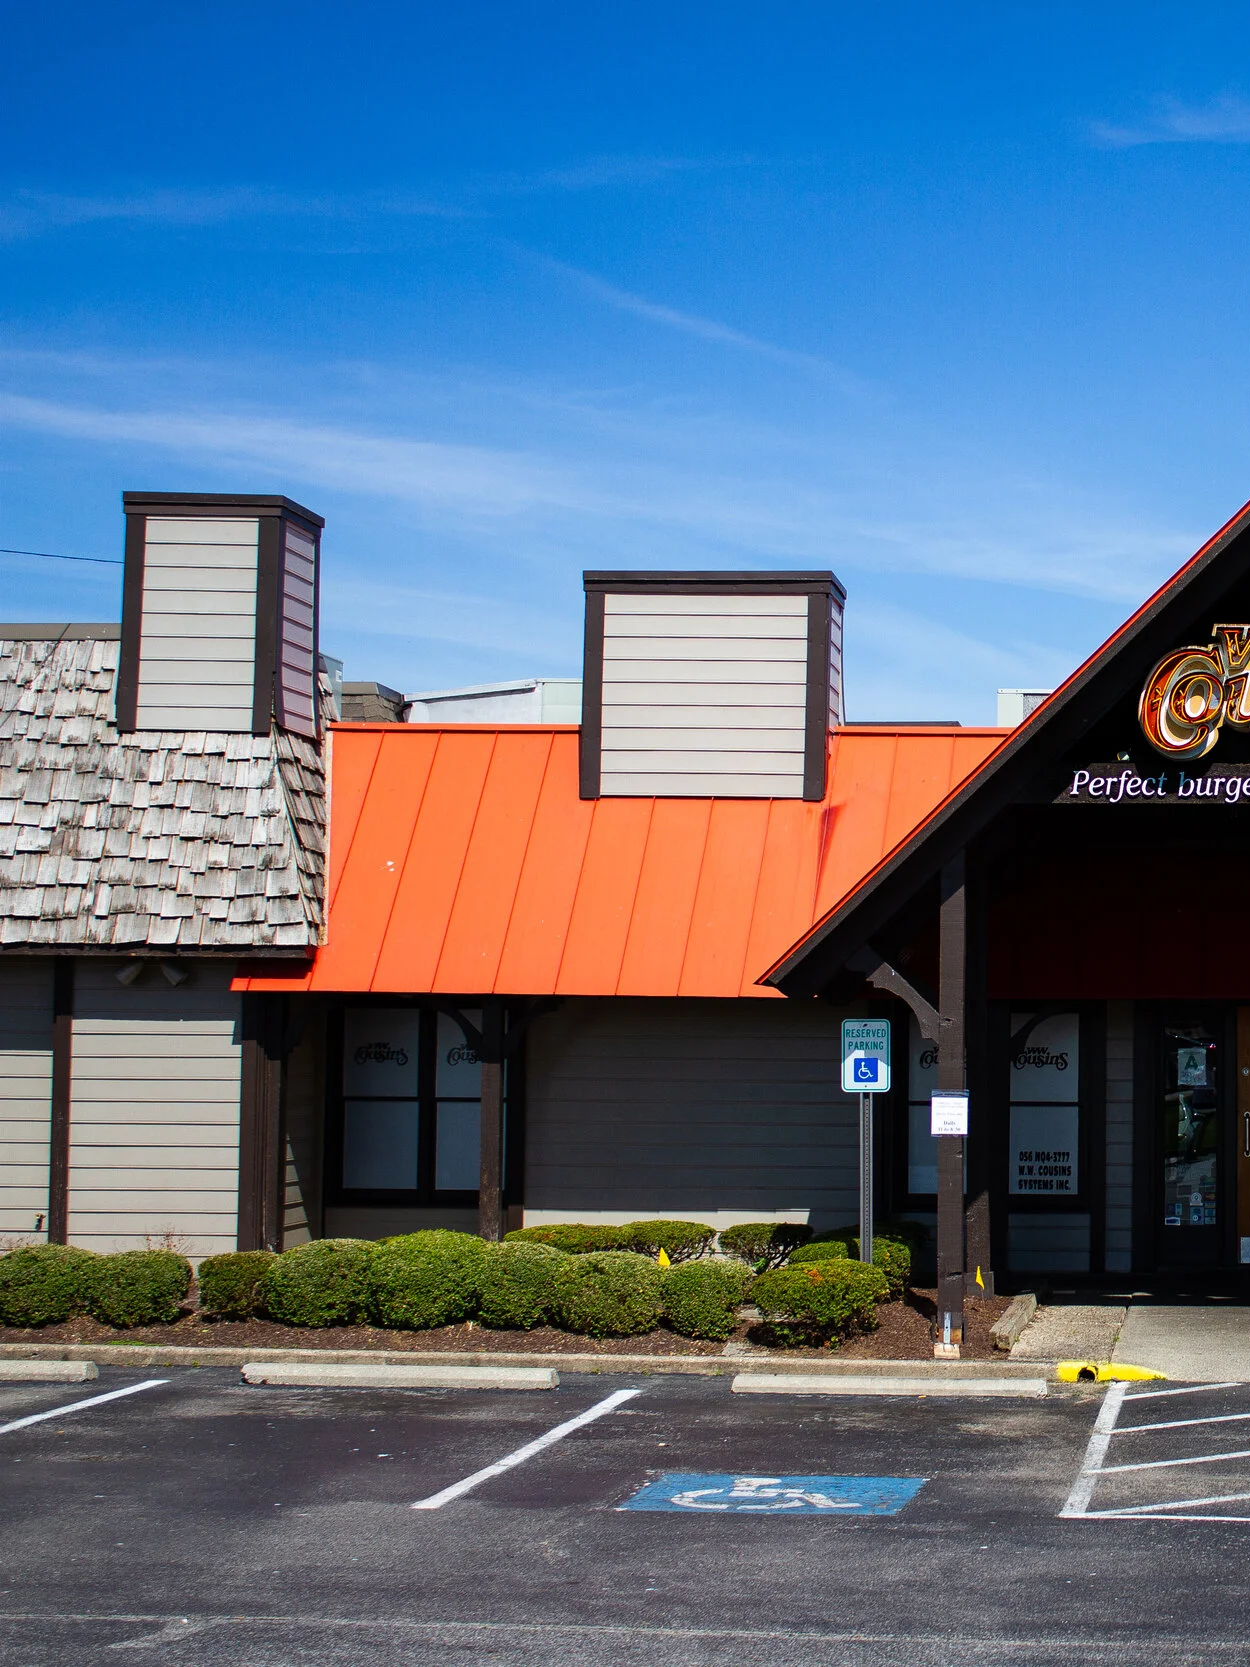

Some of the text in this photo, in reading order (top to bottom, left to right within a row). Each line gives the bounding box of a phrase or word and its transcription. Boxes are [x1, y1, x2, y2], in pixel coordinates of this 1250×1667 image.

[1069, 769, 1168, 804] Perfect
[845, 1028, 887, 1038] RESERVED
[848, 1041, 884, 1050] PARKING
[1184, 1055, 1199, 1071] A
[1038, 1165, 1072, 1176] COUSINS
[1018, 1179, 1054, 1190] SYSTEMS
